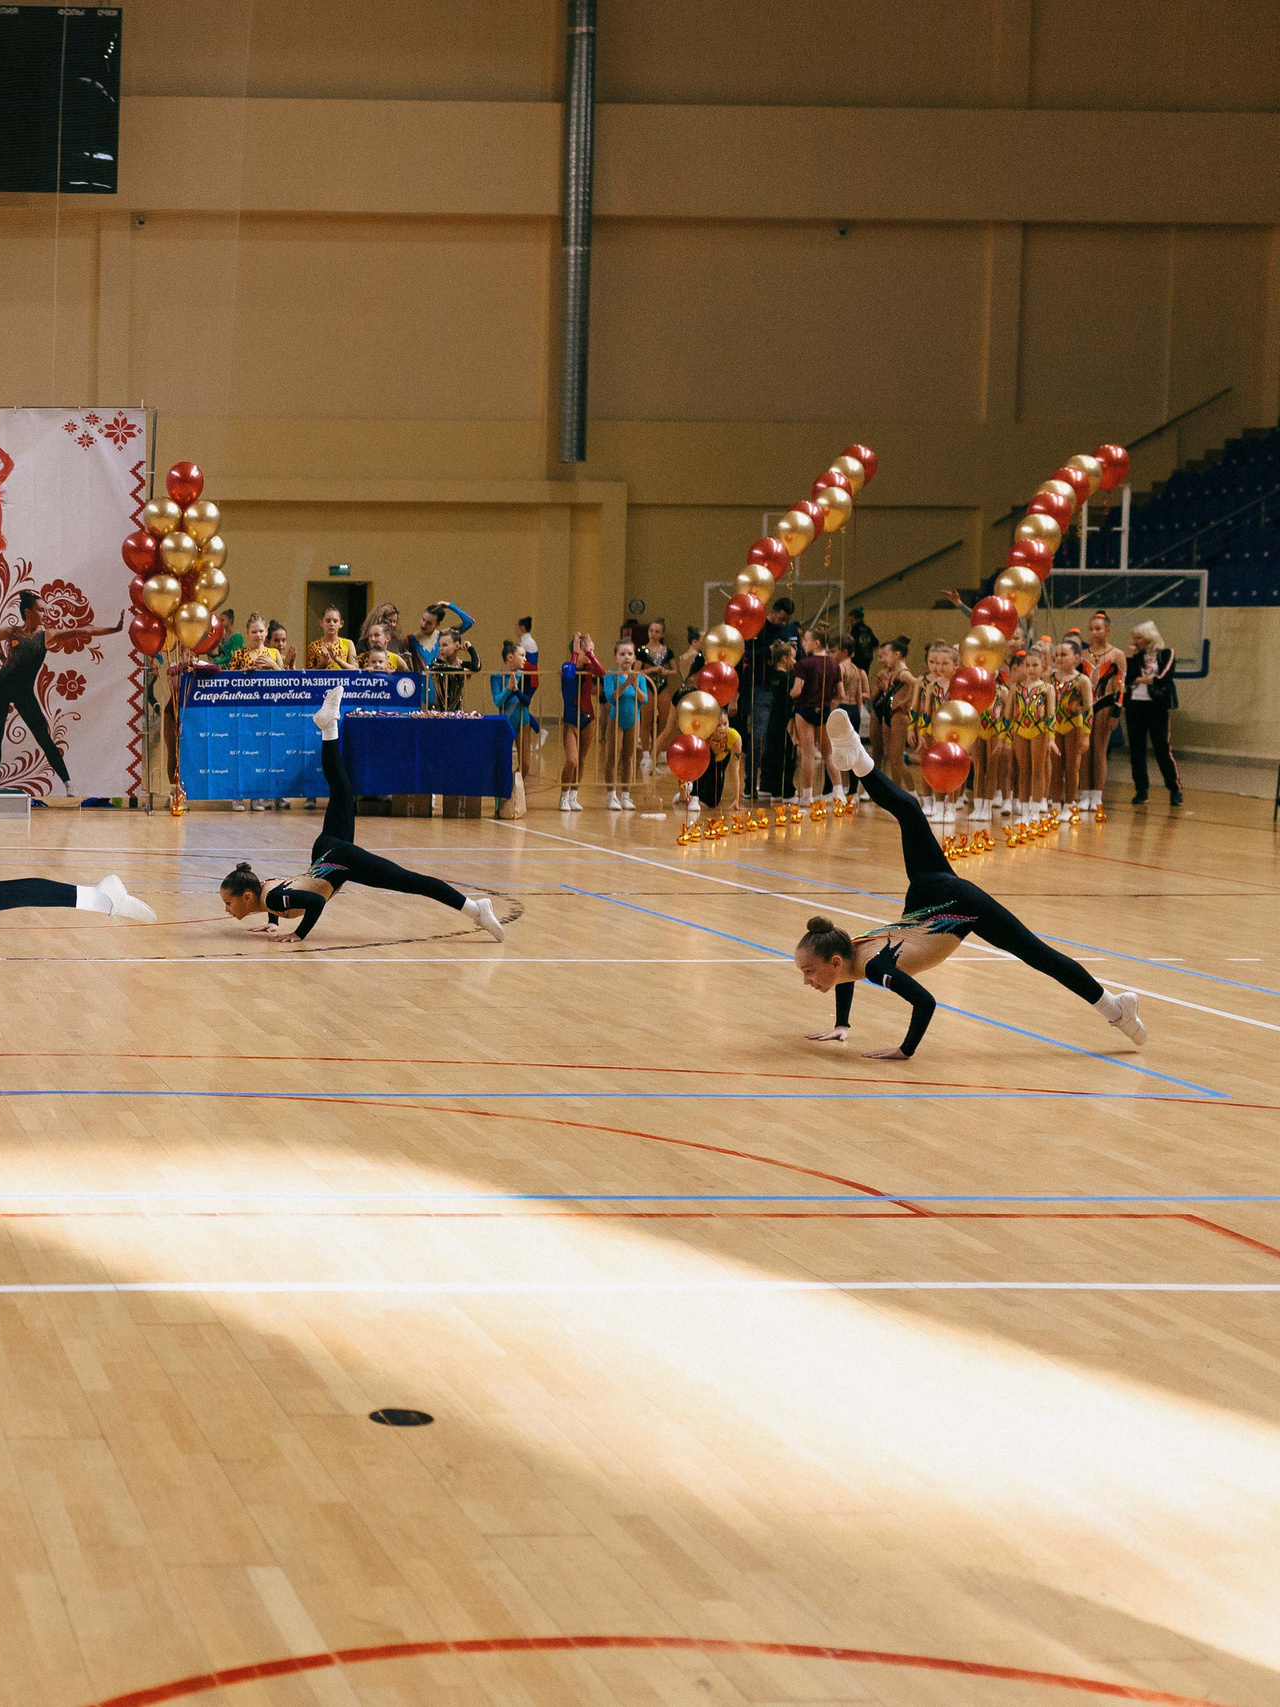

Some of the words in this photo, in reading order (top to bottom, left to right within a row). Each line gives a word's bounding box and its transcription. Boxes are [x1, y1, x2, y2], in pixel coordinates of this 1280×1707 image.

[197, 679, 230, 689] ЦЕНТР
[231, 678, 300, 687] СПОРТИВНОГО
[301, 678, 350, 687] РАЗВИТИЯ
[351, 678, 388, 687] «СТАРТ»
[193, 691, 261, 704] Спортивная
[263, 689, 312, 703] аэробика
[323, 690, 391, 700] Гнастика
